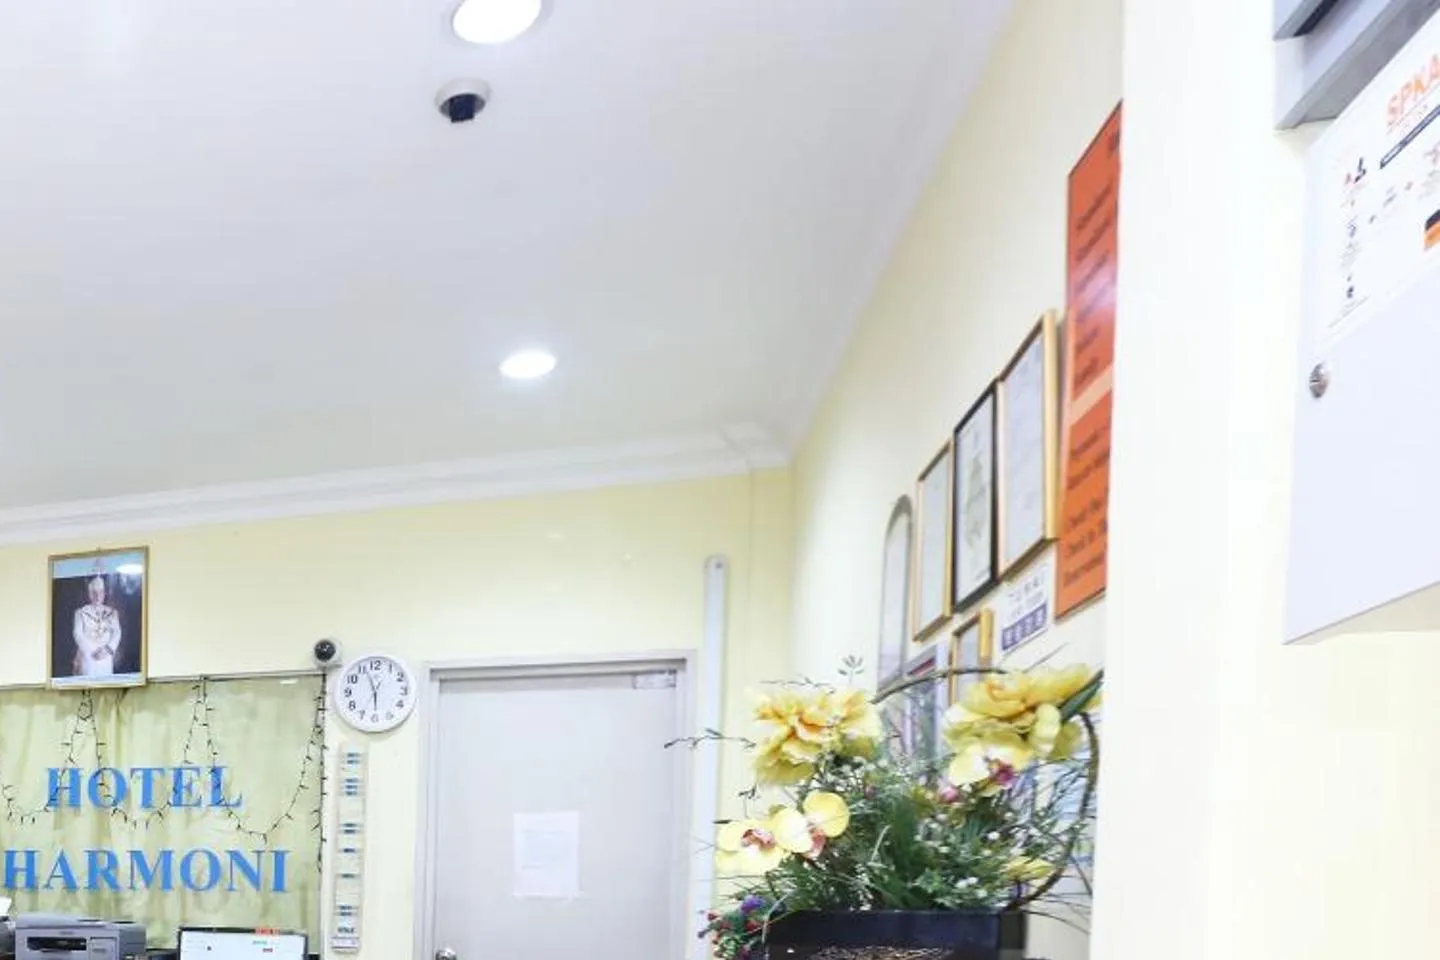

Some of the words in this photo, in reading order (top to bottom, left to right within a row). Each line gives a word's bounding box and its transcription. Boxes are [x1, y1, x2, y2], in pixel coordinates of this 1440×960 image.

[370, 660, 381, 671] 12
[347, 674, 358, 684] 10
[396, 672, 405, 683] 2
[344, 687, 352, 698] 9
[400, 686, 408, 696] 3
[348, 700, 356, 711] 8
[395, 700, 404, 709] 4
[45, 765, 243, 809] HOTEL
[3, 847, 291, 893] HARMONI
